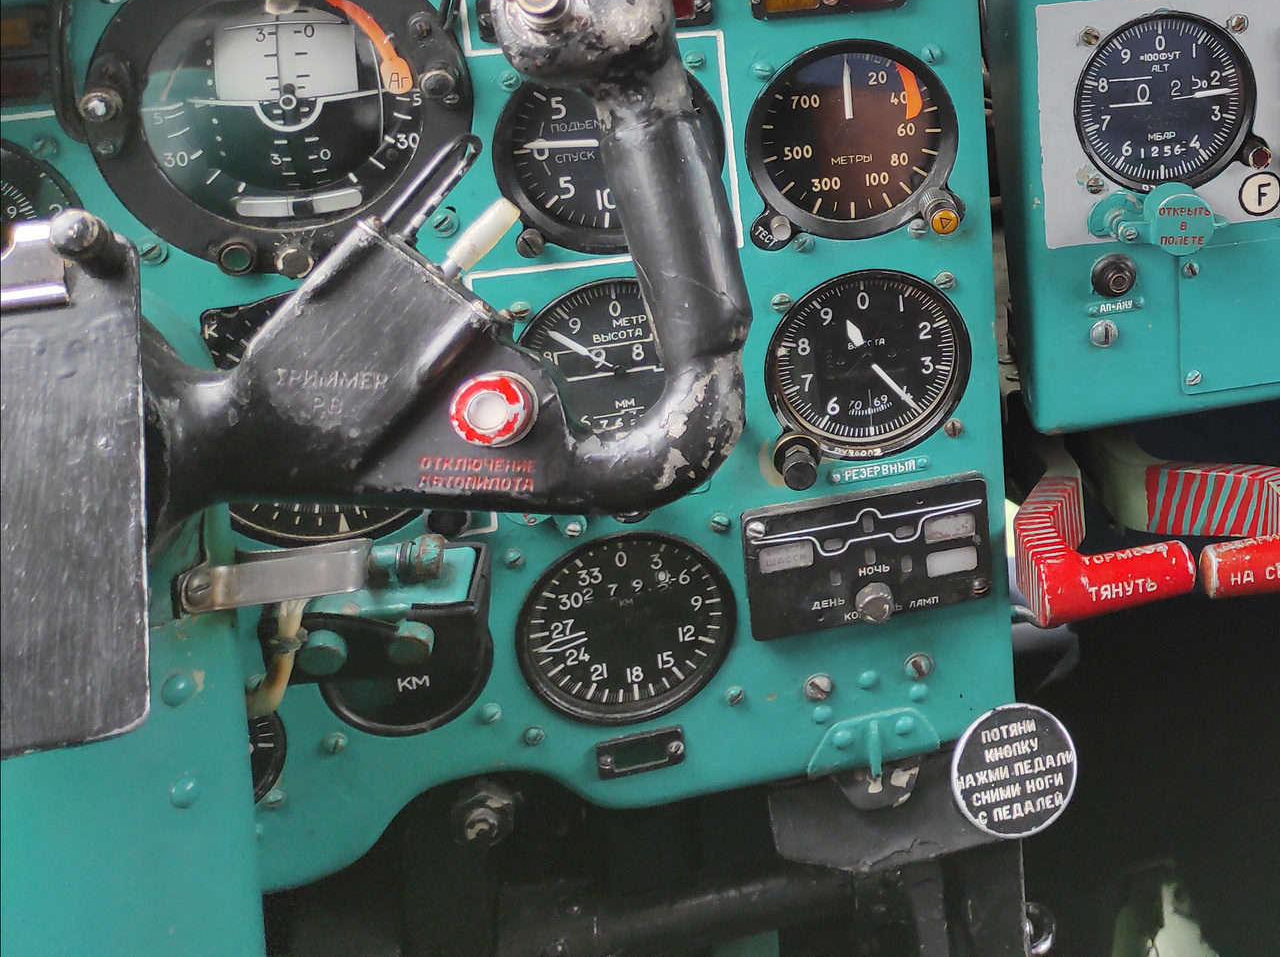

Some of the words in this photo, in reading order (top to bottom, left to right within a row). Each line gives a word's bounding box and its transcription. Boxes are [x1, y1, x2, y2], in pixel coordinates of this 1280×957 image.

[1151, 63, 1170, 73] ALT
[868, 71, 887, 86] 20
[550, 96, 566, 120] 5
[790, 93, 820, 110] 700
[897, 123, 916, 137] 60
[397, 133, 420, 149] 30
[163, 152, 188, 168] 30
[555, 150, 596, 164] СПУСК
[783, 144, 813, 161] 500
[830, 152, 873, 167] МЕТРЫ
[890, 153, 909, 167] 80
[560, 175, 576, 200] 5
[811, 176, 841, 192] 300
[865, 172, 889, 187] 100
[1257, 183, 1271, 208] F
[1158, 206, 1211, 218] ОТКРЫТЬ
[1179, 221, 1188, 232] В
[592, 327, 643, 344] ВЫСОТА
[614, 397, 636, 410] ММ
[418, 454, 536, 474] ОТКЛЮЧЕНИЕ
[844, 460, 917, 482] РЕЗЕРВНЫЙ
[418, 473, 534, 492] АВТОПИЛОТА
[577, 567, 603, 586] 33
[858, 564, 891, 577] НОЧЬ
[1230, 570, 1255, 586] НА
[1088, 576, 1158, 602] ТЯНУТЬ
[558, 592, 583, 611] 30
[811, 597, 846, 611] ДЕНЬ
[909, 596, 939, 609] ЛАМП
[551, 618, 575, 639] 27
[678, 625, 696, 642] 12
[565, 647, 590, 666] 24
[657, 651, 675, 669] 15
[590, 663, 608, 681] 21
[626, 666, 644, 684] 18
[981, 718, 1037, 744] ПОТЯНИ
[984, 737, 1039, 764] КНОПКУ
[972, 781, 1022, 807] СНИМИ
[1025, 771, 1064, 794] НОГИ
[978, 810, 988, 825] С
[993, 790, 1064, 823] ПЕДАЛЕЙ
